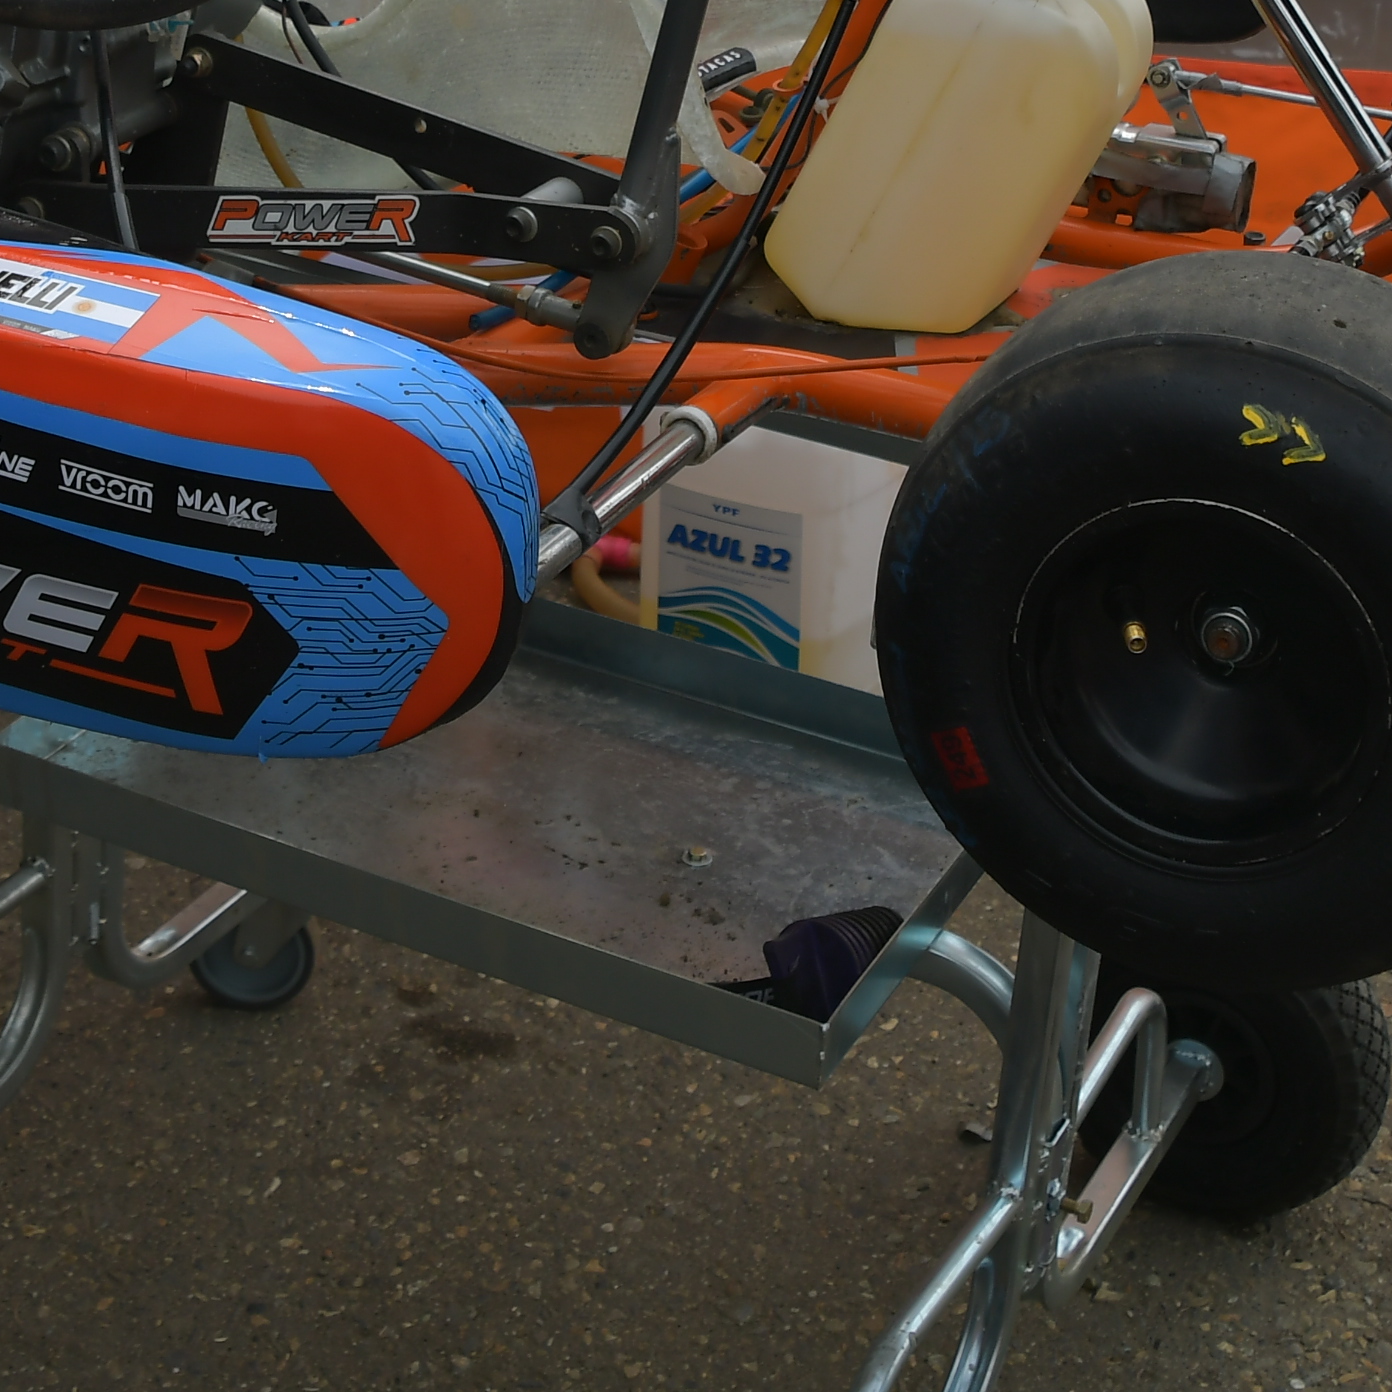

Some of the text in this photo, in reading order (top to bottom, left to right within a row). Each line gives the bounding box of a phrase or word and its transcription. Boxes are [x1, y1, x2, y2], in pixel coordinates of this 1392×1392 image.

[211, 198, 416, 243] POWER
[277, 230, 352, 243] KART
[667, 524, 745, 563] AZUL
[752, 544, 791, 572] 32
